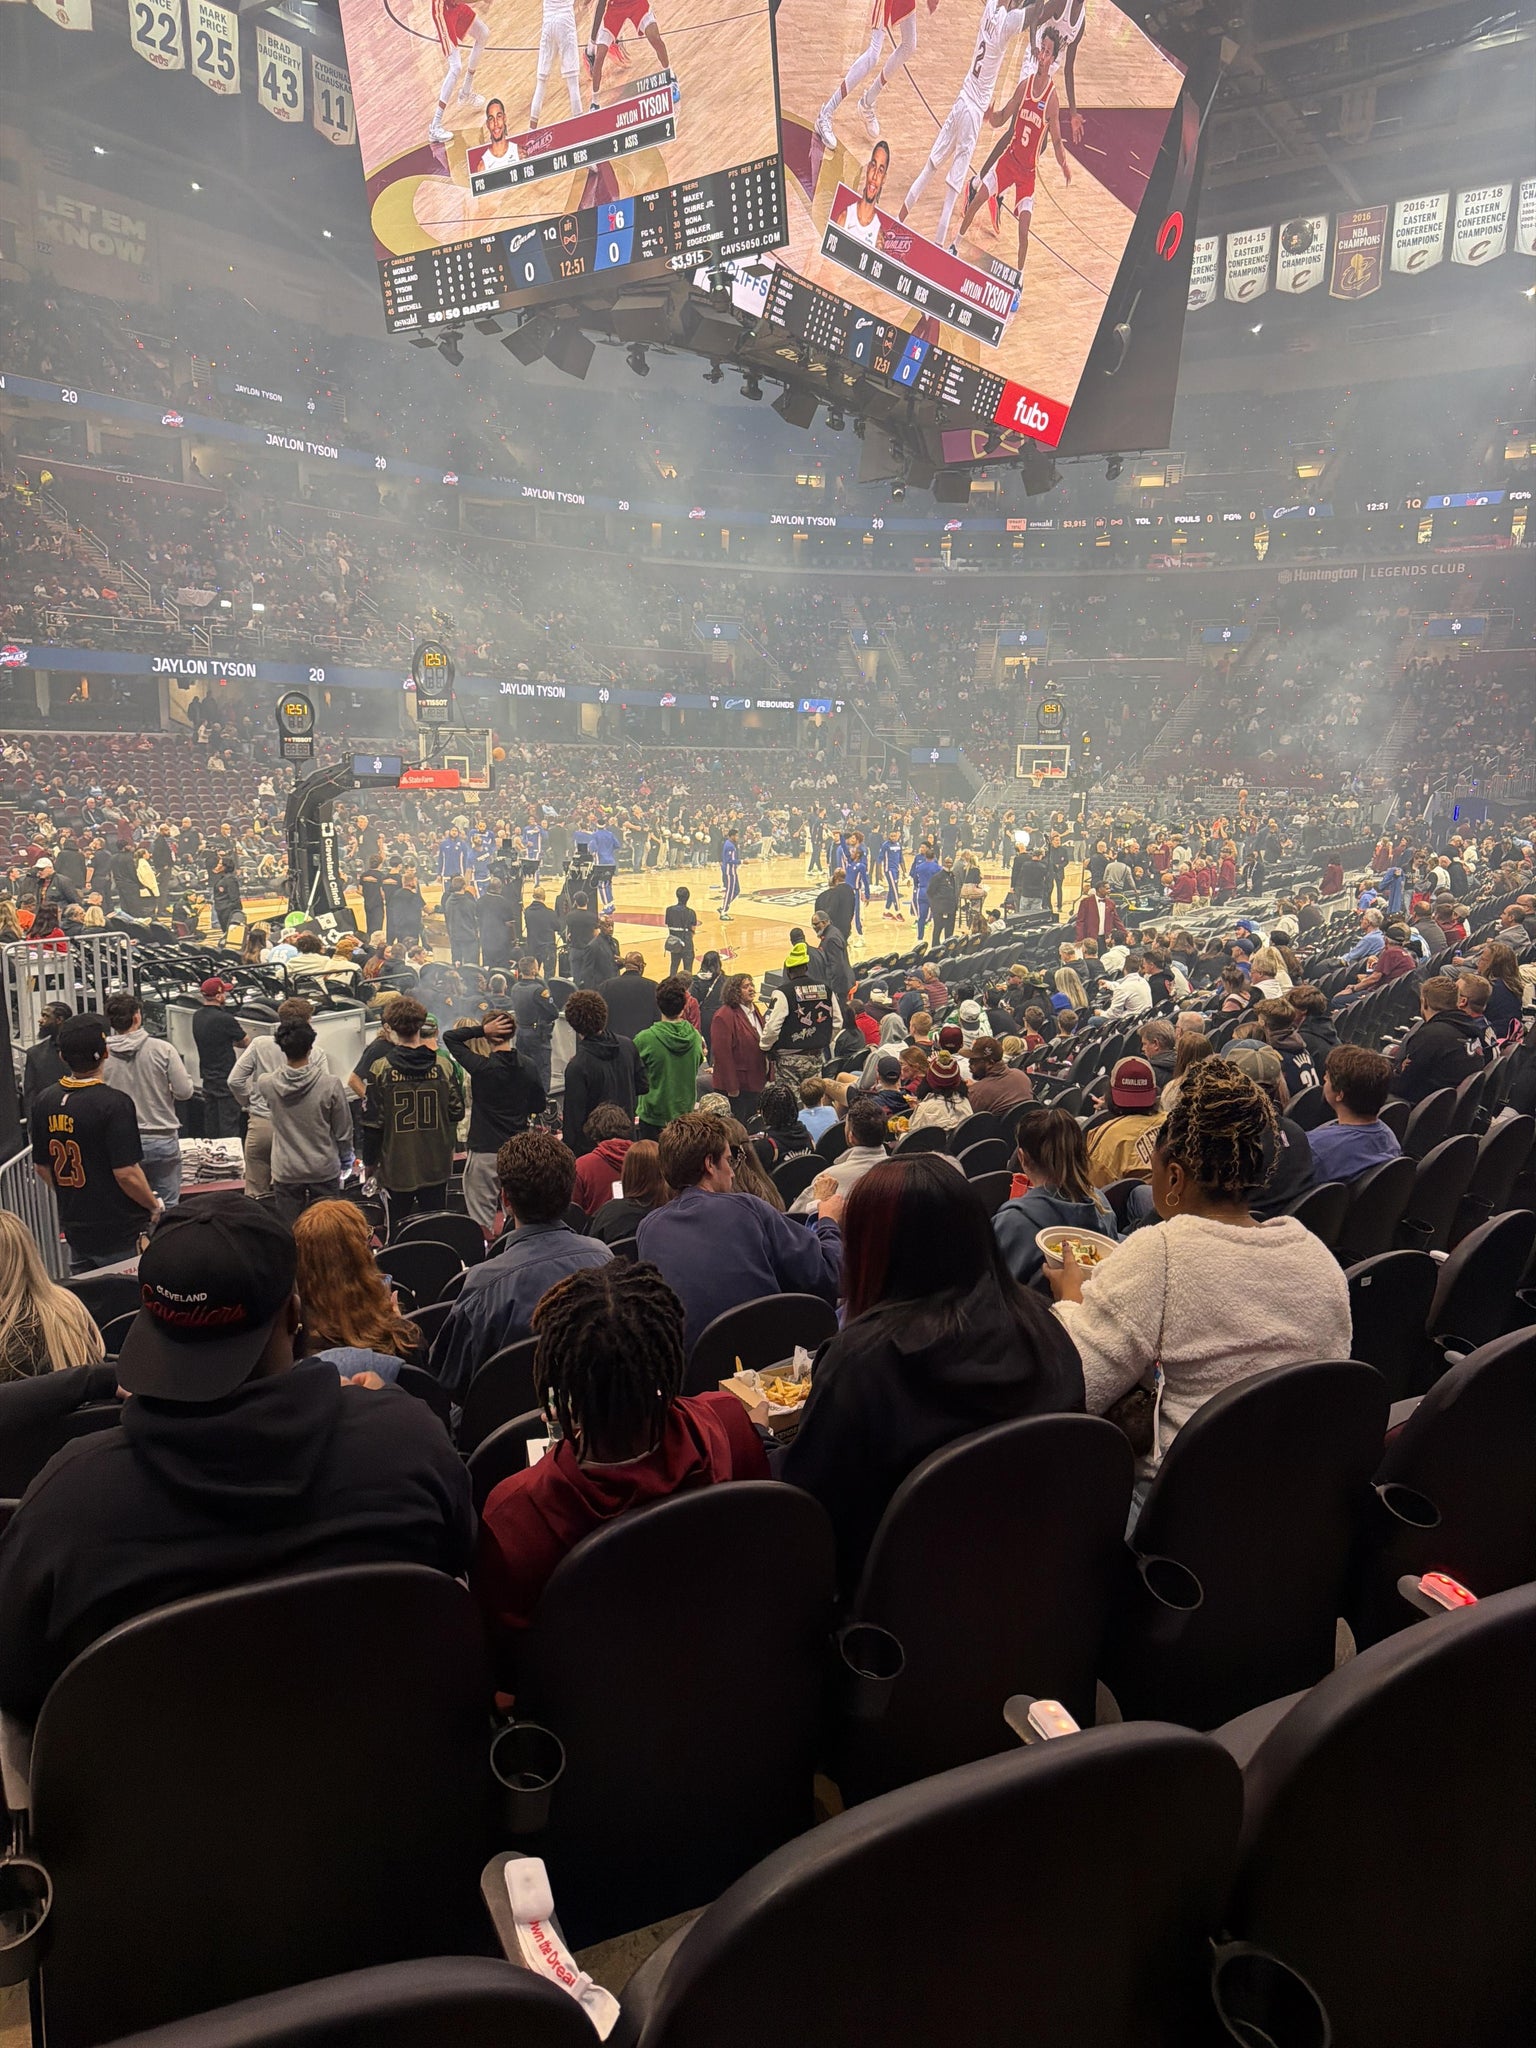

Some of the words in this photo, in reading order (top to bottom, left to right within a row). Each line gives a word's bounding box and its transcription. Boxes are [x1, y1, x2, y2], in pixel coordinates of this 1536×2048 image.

[200, 5, 227, 23] MARK
[136, 3, 178, 56] 22
[200, 16, 228, 36] PRICE
[268, 37, 291, 55] BRAD
[196, 30, 235, 80] 25
[972, 41, 986, 79] 2
[263, 62, 298, 108] 43
[650, 78, 658, 88] VS
[321, 89, 348, 132] 11
[616, 109, 638, 128] JAYLON
[638, 93, 669, 120] TYSON
[1021, 126, 1031, 147] 5
[475, 178, 485, 191] PTS
[510, 169, 518, 182] 18
[524, 165, 534, 178] FGS
[553, 155, 567, 170] 6/14
[574, 150, 588, 164] REBS
[614, 140, 618, 153] 3
[625, 135, 638, 148] ASTS
[666, 123, 671, 136] 2
[753, 162, 764, 171] AST
[766, 158, 777, 167] FLS
[642, 192, 659, 202] FOULS
[683, 192, 704, 203] MAXEY
[1464, 188, 1503, 203] 2017-18
[649, 203, 654, 211] 0
[684, 202, 704, 214] OUBRE
[1403, 198, 1440, 212] 2016-17
[1465, 202, 1500, 216] EASTERN
[37, 190, 97, 224] LET
[102, 208, 146, 240] EM
[685, 215, 702, 225] BONA
[1353, 212, 1371, 223] 2016
[1404, 212, 1437, 226] EASTERN
[1456, 211, 1506, 228] CONFERENCE
[543, 228, 557, 240] 1Q
[685, 223, 711, 236] WALKER
[1353, 227, 1368, 238] NBA
[1396, 222, 1442, 238] CONFERENCE
[1458, 224, 1503, 239] CHAMPIONS
[39, 216, 145, 265] KNOW
[480, 236, 496, 244] FOULS
[687, 231, 724, 247] EDGECOMBE
[1233, 233, 1266, 246] 2014-15
[1338, 235, 1380, 250] CHAMPIONS
[1397, 234, 1439, 248] CHAMPIONS
[609, 242, 619, 263] 0
[643, 250, 653, 258] TOL
[664, 246, 668, 254] 7
[671, 251, 704, 271] $3,915
[721, 232, 780, 256] CAVS5050.COM
[1234, 245, 1264, 258] EASTERN
[560, 257, 585, 276] 12:51
[1228, 254, 1269, 268] CONFERENCE
[1282, 255, 1321, 268] CHAMPIONS
[524, 262, 534, 281] 0
[1229, 265, 1266, 279] CHAMPIONS
[826, 234, 838, 253] PTS
[858, 253, 867, 270] 18
[871, 261, 883, 278] FGS
[897, 276, 911, 295] 6/14
[914, 285, 929, 304] REBS
[948, 303, 955, 318] 3
[958, 309, 972, 327] ASTS
[992, 326, 999, 341] 2
[960, 279, 982, 301] JAYLON
[982, 282, 1011, 315] TYSON
[394, 314, 417, 328] oswald
[463, 301, 500, 315] RAFFLE
[856, 342, 863, 357] 0
[874, 356, 890, 373] 12:51
[902, 365, 910, 379] 0
[61, 389, 78, 403] 20
[235, 384, 261, 398] JAYLON
[262, 390, 283, 402] TYSON
[1014, 396, 1049, 431] fubo
[266, 433, 304, 452] JAYLON
[306, 441, 338, 459] TYSON
[521, 487, 555, 501] JAYLON
[557, 491, 585, 504] TYSON
[618, 501, 629, 511] 20
[1063, 520, 1086, 528] $3,915
[1157, 517, 1163, 525] 7
[1175, 515, 1200, 524] FOULS
[1207, 515, 1213, 523] 0
[1223, 511, 1242, 522] FG%
[1249, 510, 1256, 521] 0
[1308, 506, 1316, 517] 0
[1366, 501, 1389, 511] 12:51
[1405, 498, 1421, 509] 1Q
[1442, 495, 1451, 506] 0
[1509, 491, 1531, 501] FG%
[770, 515, 804, 526] JAYLON
[806, 517, 836, 527] TYSON
[1294, 569, 1358, 582] Huntington
[1370, 566, 1427, 578] LEGENDS
[1432, 563, 1465, 574] CLUB
[152, 658, 207, 676] JAYLON
[210, 661, 256, 678] TYSON
[309, 668, 325, 682] 20
[499, 682, 535, 697] JAYLON
[536, 685, 566, 698] TYSON
[745, 699, 750, 708] 0
[757, 700, 794, 708] REBOUNDS
[804, 701, 809, 710] 0
[325, 838, 336, 880] Cleveland
[329, 882, 341, 906] Clinic
[1122, 1078, 1148, 1086] CAVALIERS
[394, 1088, 438, 1133] 20
[48, 1114, 74, 1133] JAMES
[49, 1139, 87, 1189] 23
[156, 1285, 208, 1303] CLEVELAND
[141, 1283, 247, 1326] Cavaliers
[539, 1940, 552, 1955] the
